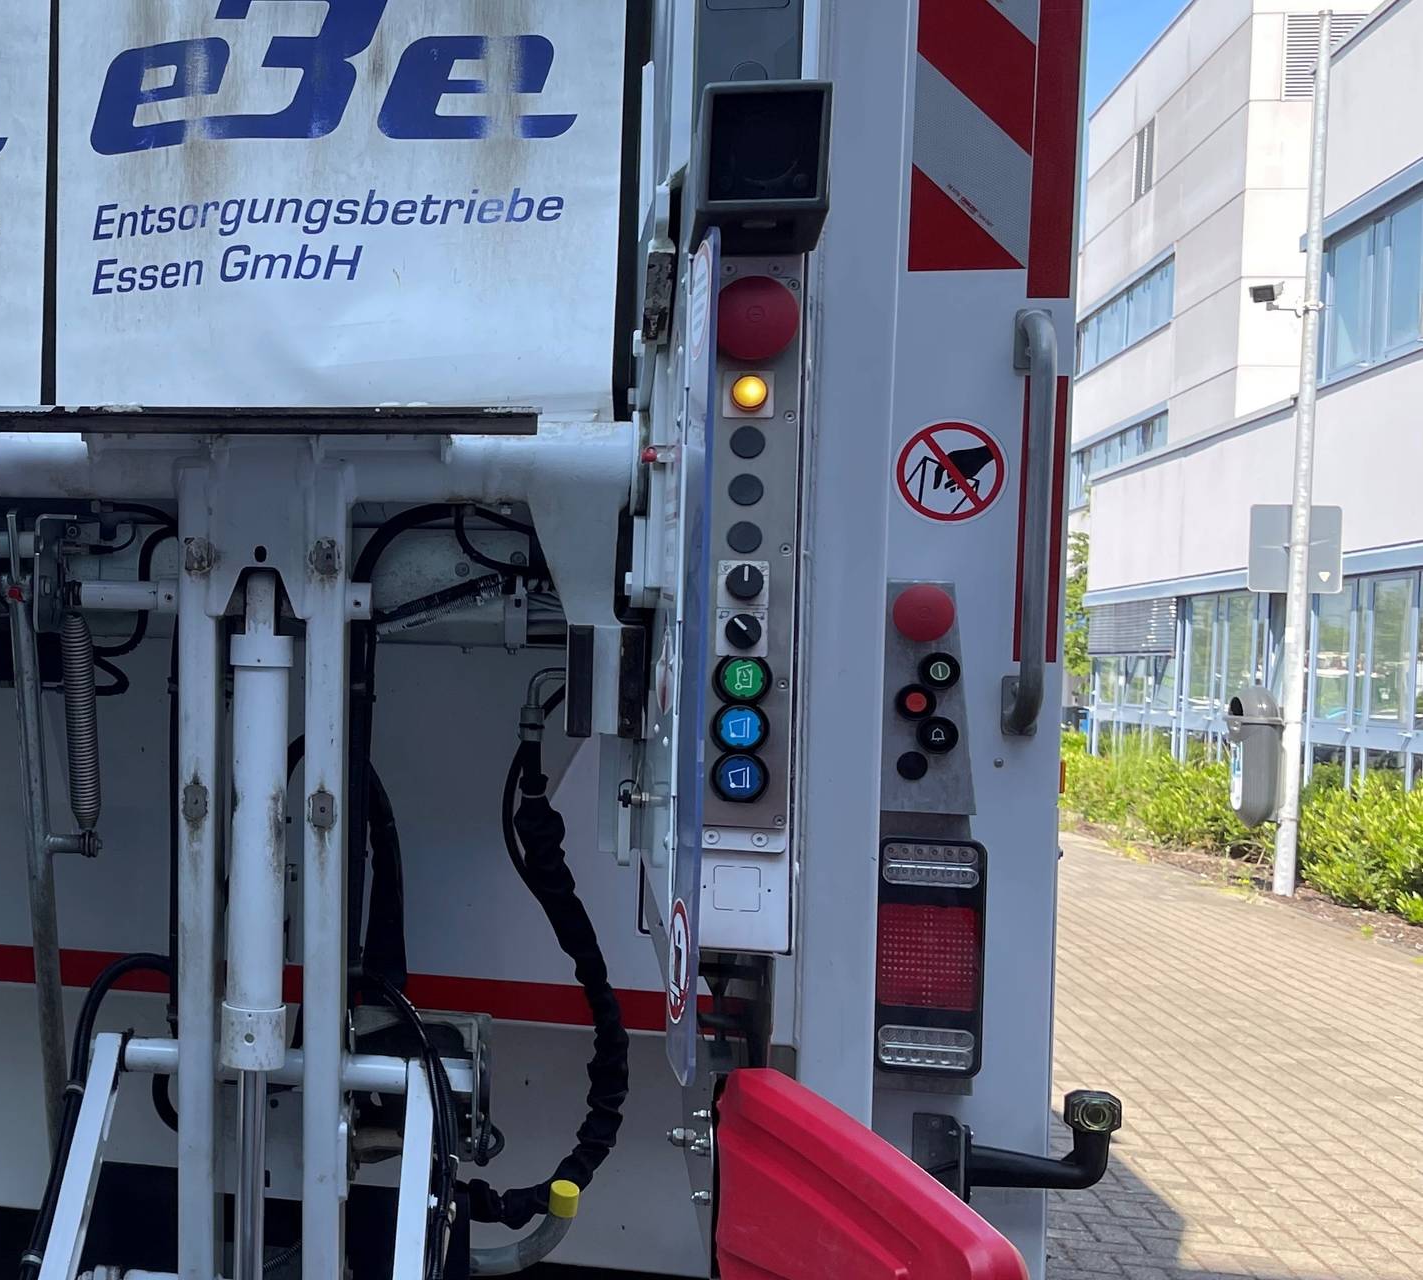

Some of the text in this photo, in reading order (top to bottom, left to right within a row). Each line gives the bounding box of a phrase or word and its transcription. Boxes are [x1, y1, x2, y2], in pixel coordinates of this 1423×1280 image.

[92, 187, 565, 242] Entsorgungsbetriebe
[92, 243, 364, 296] Essen GmbH
